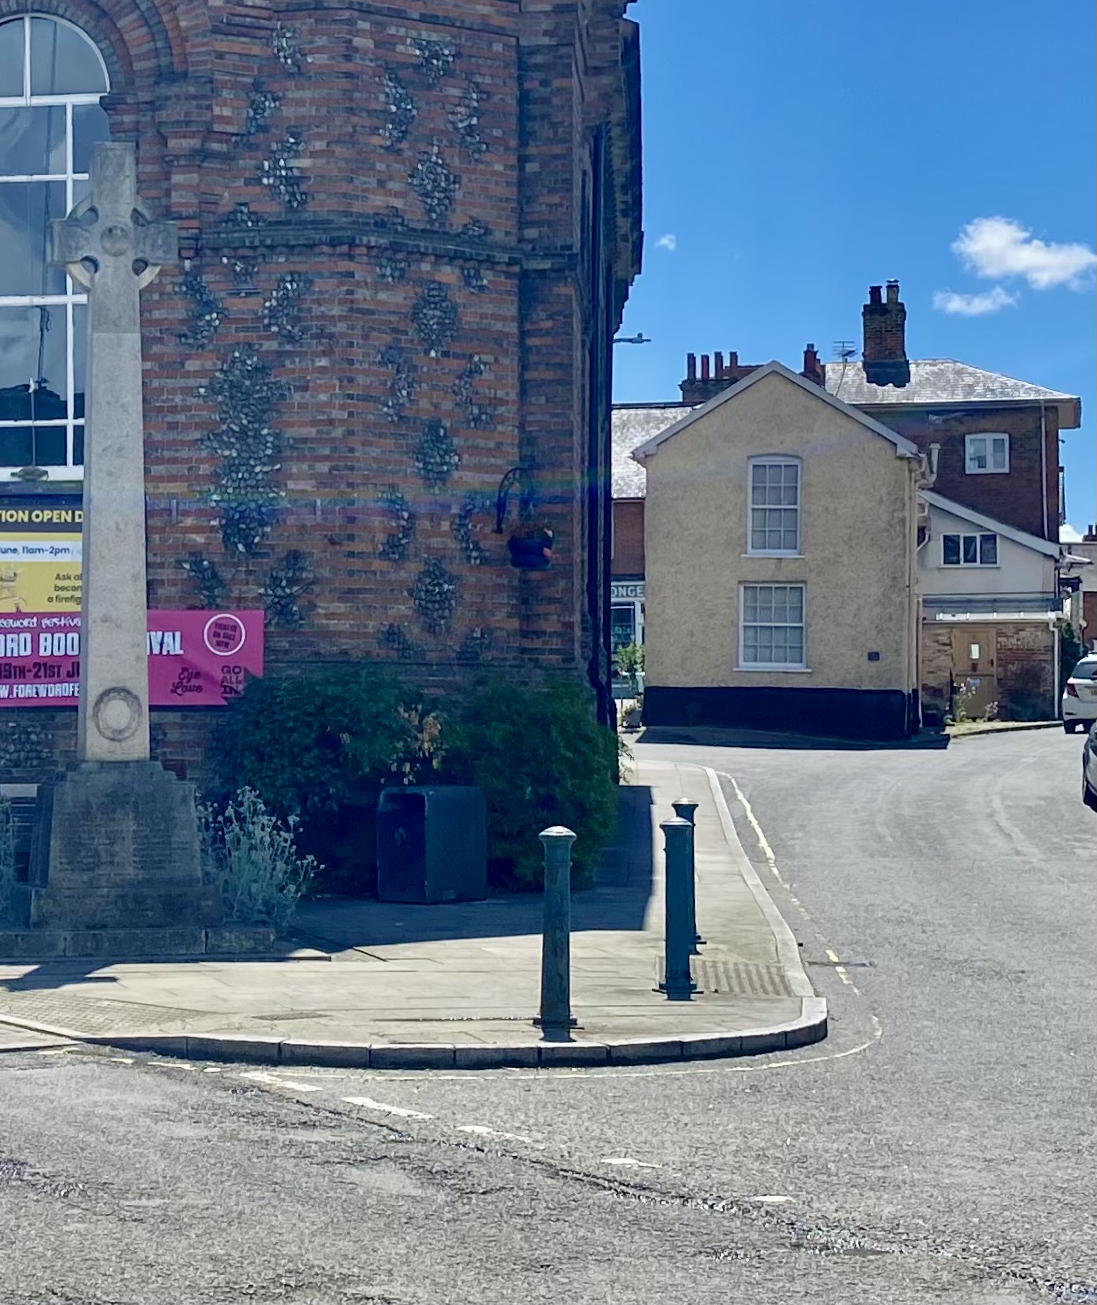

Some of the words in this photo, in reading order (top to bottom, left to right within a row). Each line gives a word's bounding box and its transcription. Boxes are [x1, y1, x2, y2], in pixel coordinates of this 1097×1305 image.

[31, 509, 72, 523] OPEN
[21, 545, 71, 556] 11am-2pm
[54, 572, 72, 581] Ask
[221, 665, 243, 674] GO
[178, 666, 202, 684] Eye
[221, 675, 243, 685] ALL
